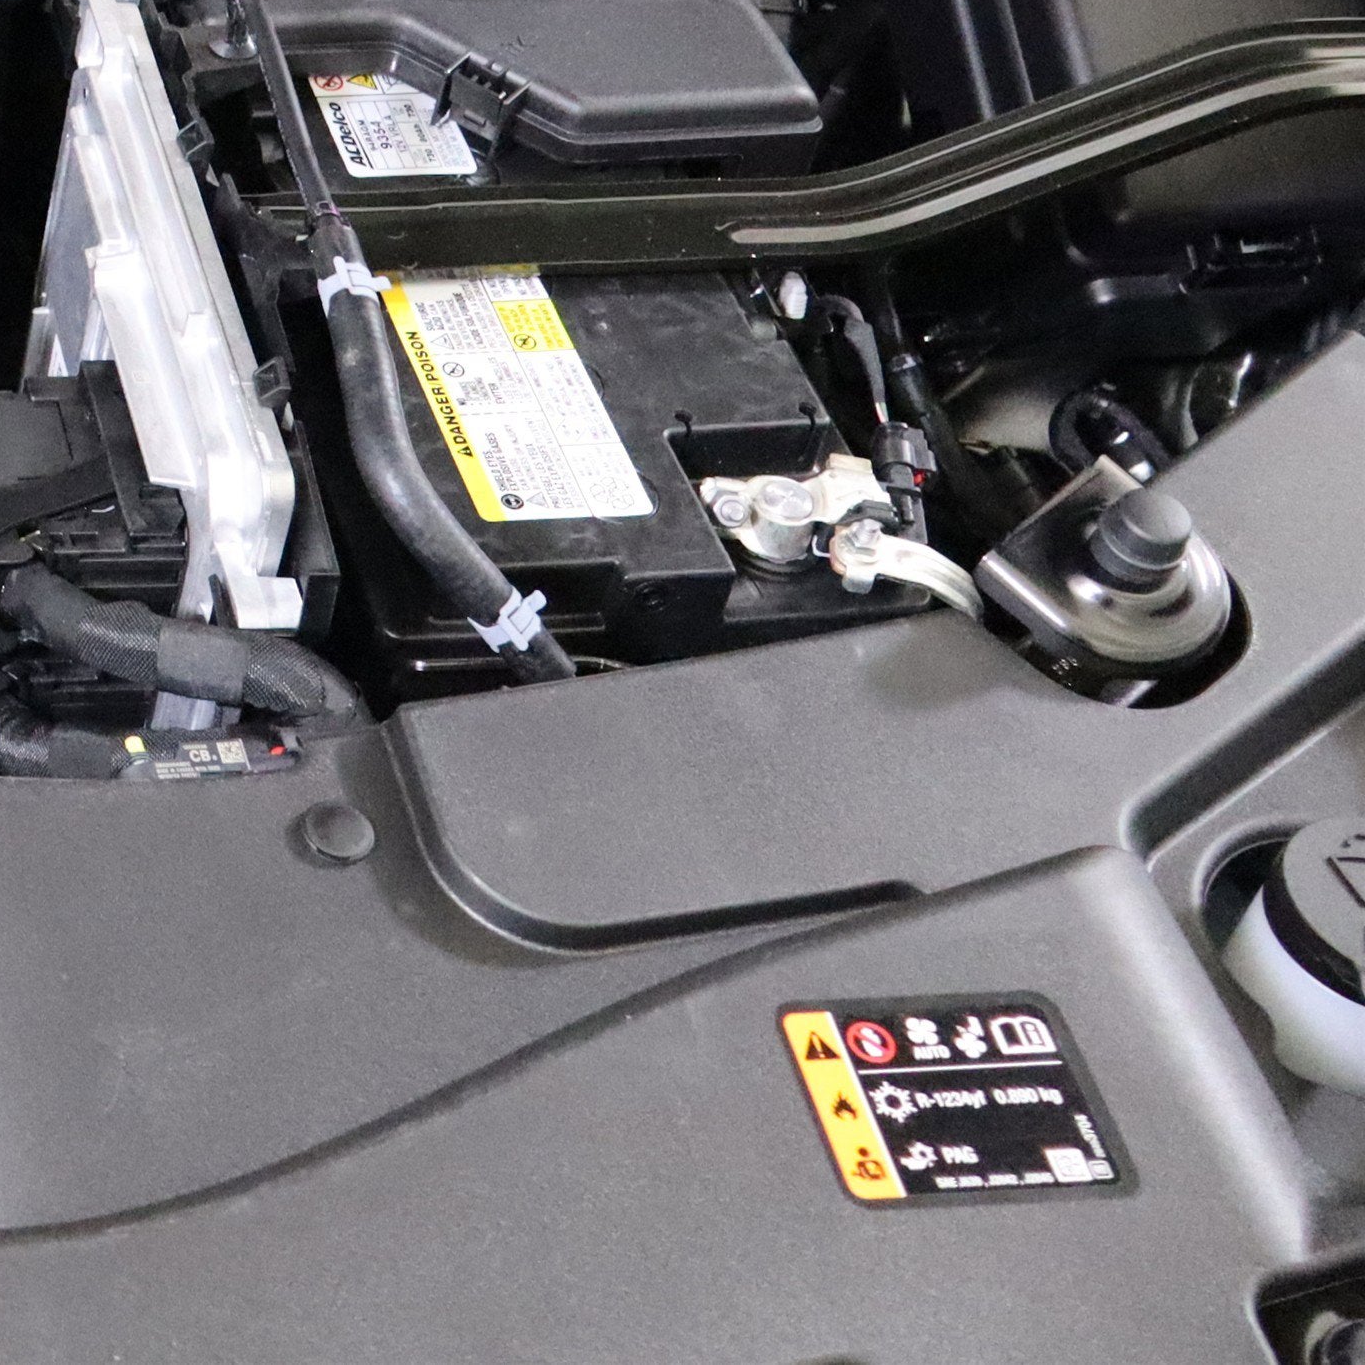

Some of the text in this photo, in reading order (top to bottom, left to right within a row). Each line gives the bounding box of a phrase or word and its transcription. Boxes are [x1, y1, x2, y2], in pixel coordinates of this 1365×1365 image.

[329, 102, 364, 165] ACDelco
[370, 121, 392, 149] 9354
[913, 1045, 950, 1059] AUTO
